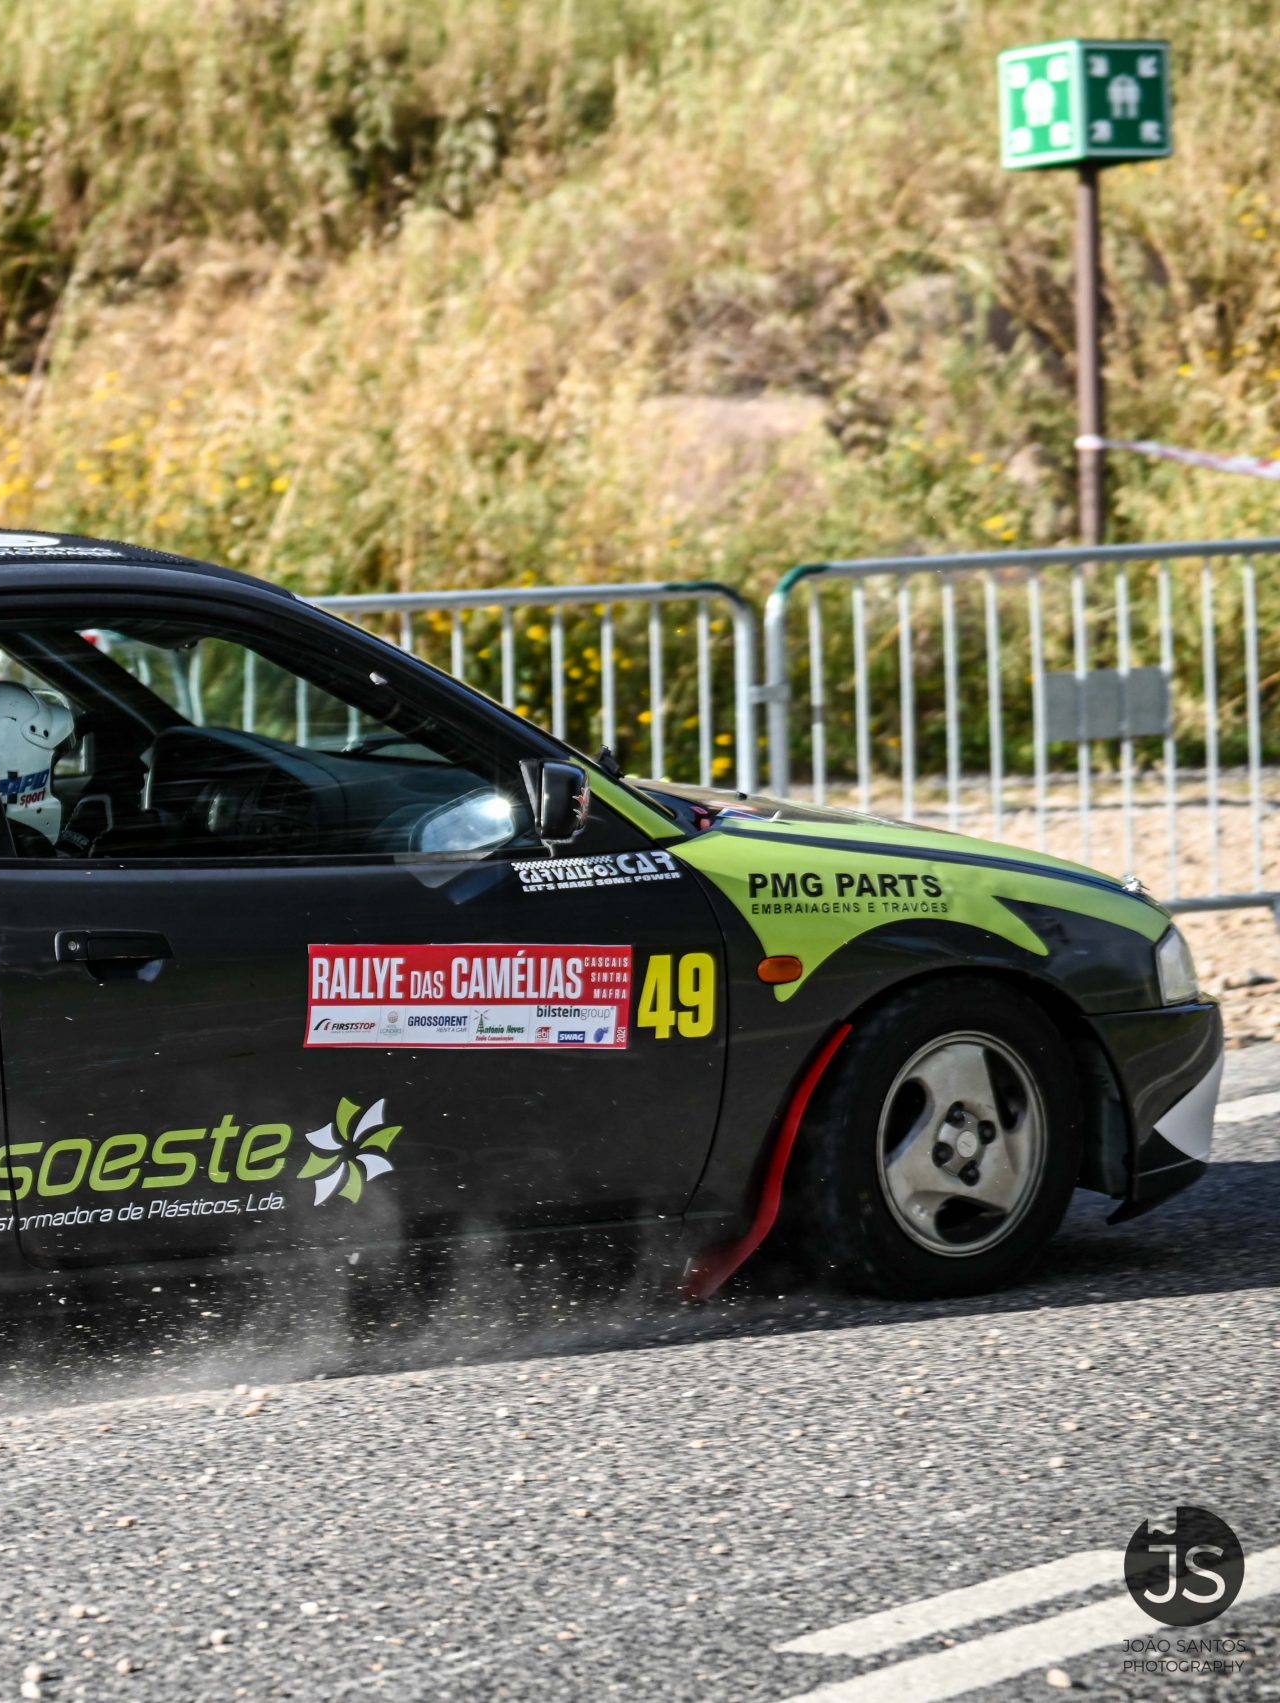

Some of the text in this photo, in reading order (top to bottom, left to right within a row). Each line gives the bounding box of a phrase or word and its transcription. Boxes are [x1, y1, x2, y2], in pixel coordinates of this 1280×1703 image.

[19, 787, 46, 809] sport
[616, 850, 677, 875] CAR
[522, 871, 681, 893] LET'S MAKE SOME POWER
[748, 872, 944, 898] PMG PARTS
[751, 900, 949, 915] EMBRAIAGENS E TRAVÕES
[584, 956, 630, 968] CASCAIS
[311, 950, 584, 1000] RALLYE DAS CAMÉLIAS
[590, 972, 629, 984] SINTRA
[593, 988, 628, 1000] MAFRA
[637, 952, 715, 1039] 49
[330, 1022, 376, 1031] FIRSTSTOP
[407, 1015, 468, 1027] GROSSORENT
[558, 1033, 585, 1041] SWAG
[116, 1202, 142, 1221] de
[148, 1195, 243, 1218] Plásticos,
[245, 1191, 286, 1212] Lda.
